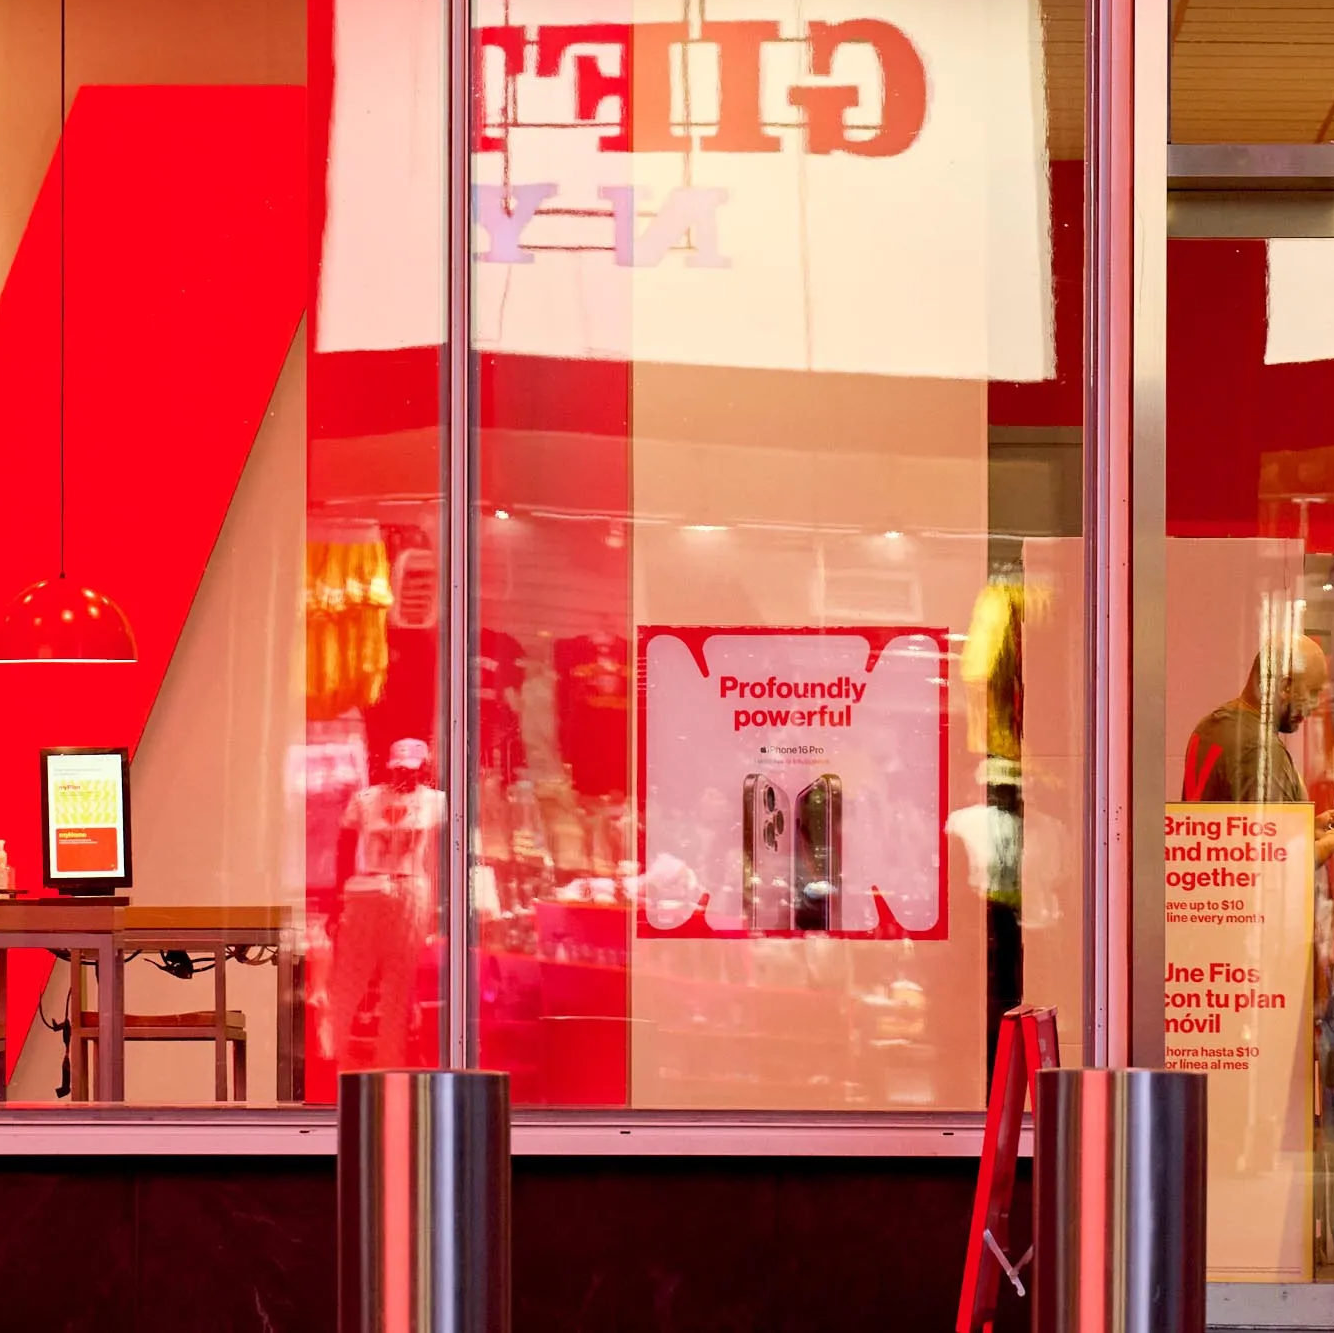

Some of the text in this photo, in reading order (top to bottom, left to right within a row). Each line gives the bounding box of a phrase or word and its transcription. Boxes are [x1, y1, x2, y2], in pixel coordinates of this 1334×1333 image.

[720, 676, 867, 704] Profoundly
[734, 705, 852, 731] powerful
[798, 746, 808, 754] 16
[809, 746, 824, 754] Pro
[1226, 816, 1277, 837] Fios
[1206, 842, 1288, 862] mobile
[1165, 867, 1260, 891] ogether
[1166, 899, 1244, 913] ave up to $10
[1166, 912, 1265, 925] line every month
[1209, 963, 1260, 983] Fios
[1206, 989, 1229, 1008] tu
[1234, 988, 1286, 1012] plan
[1166, 1046, 1260, 1058] horra hasta $10
[1165, 1059, 1249, 1070] or línea al mes
